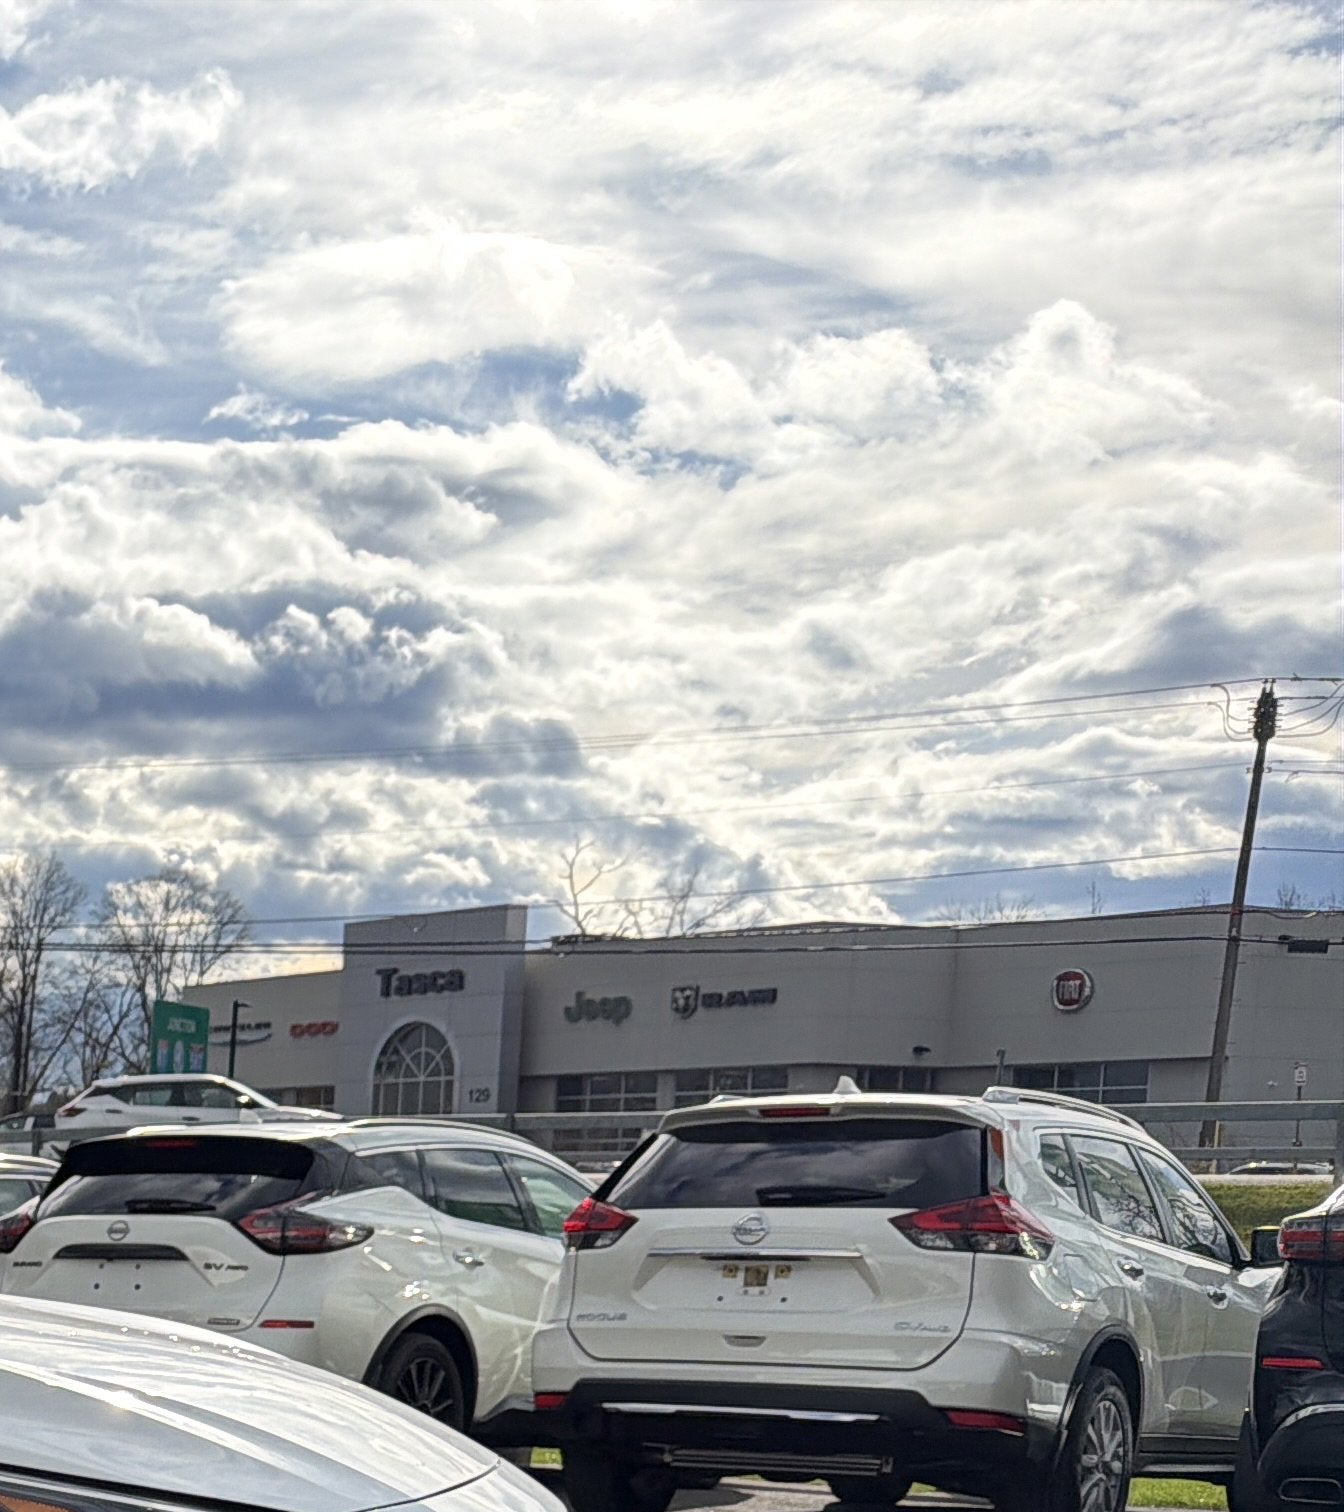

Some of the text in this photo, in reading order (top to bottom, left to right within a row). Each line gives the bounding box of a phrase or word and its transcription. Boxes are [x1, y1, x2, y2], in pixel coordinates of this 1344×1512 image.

[375, 966, 466, 998] Tasca
[564, 990, 633, 1027] Jeep
[700, 987, 778, 1009] RAM
[468, 1088, 492, 1103] 129
